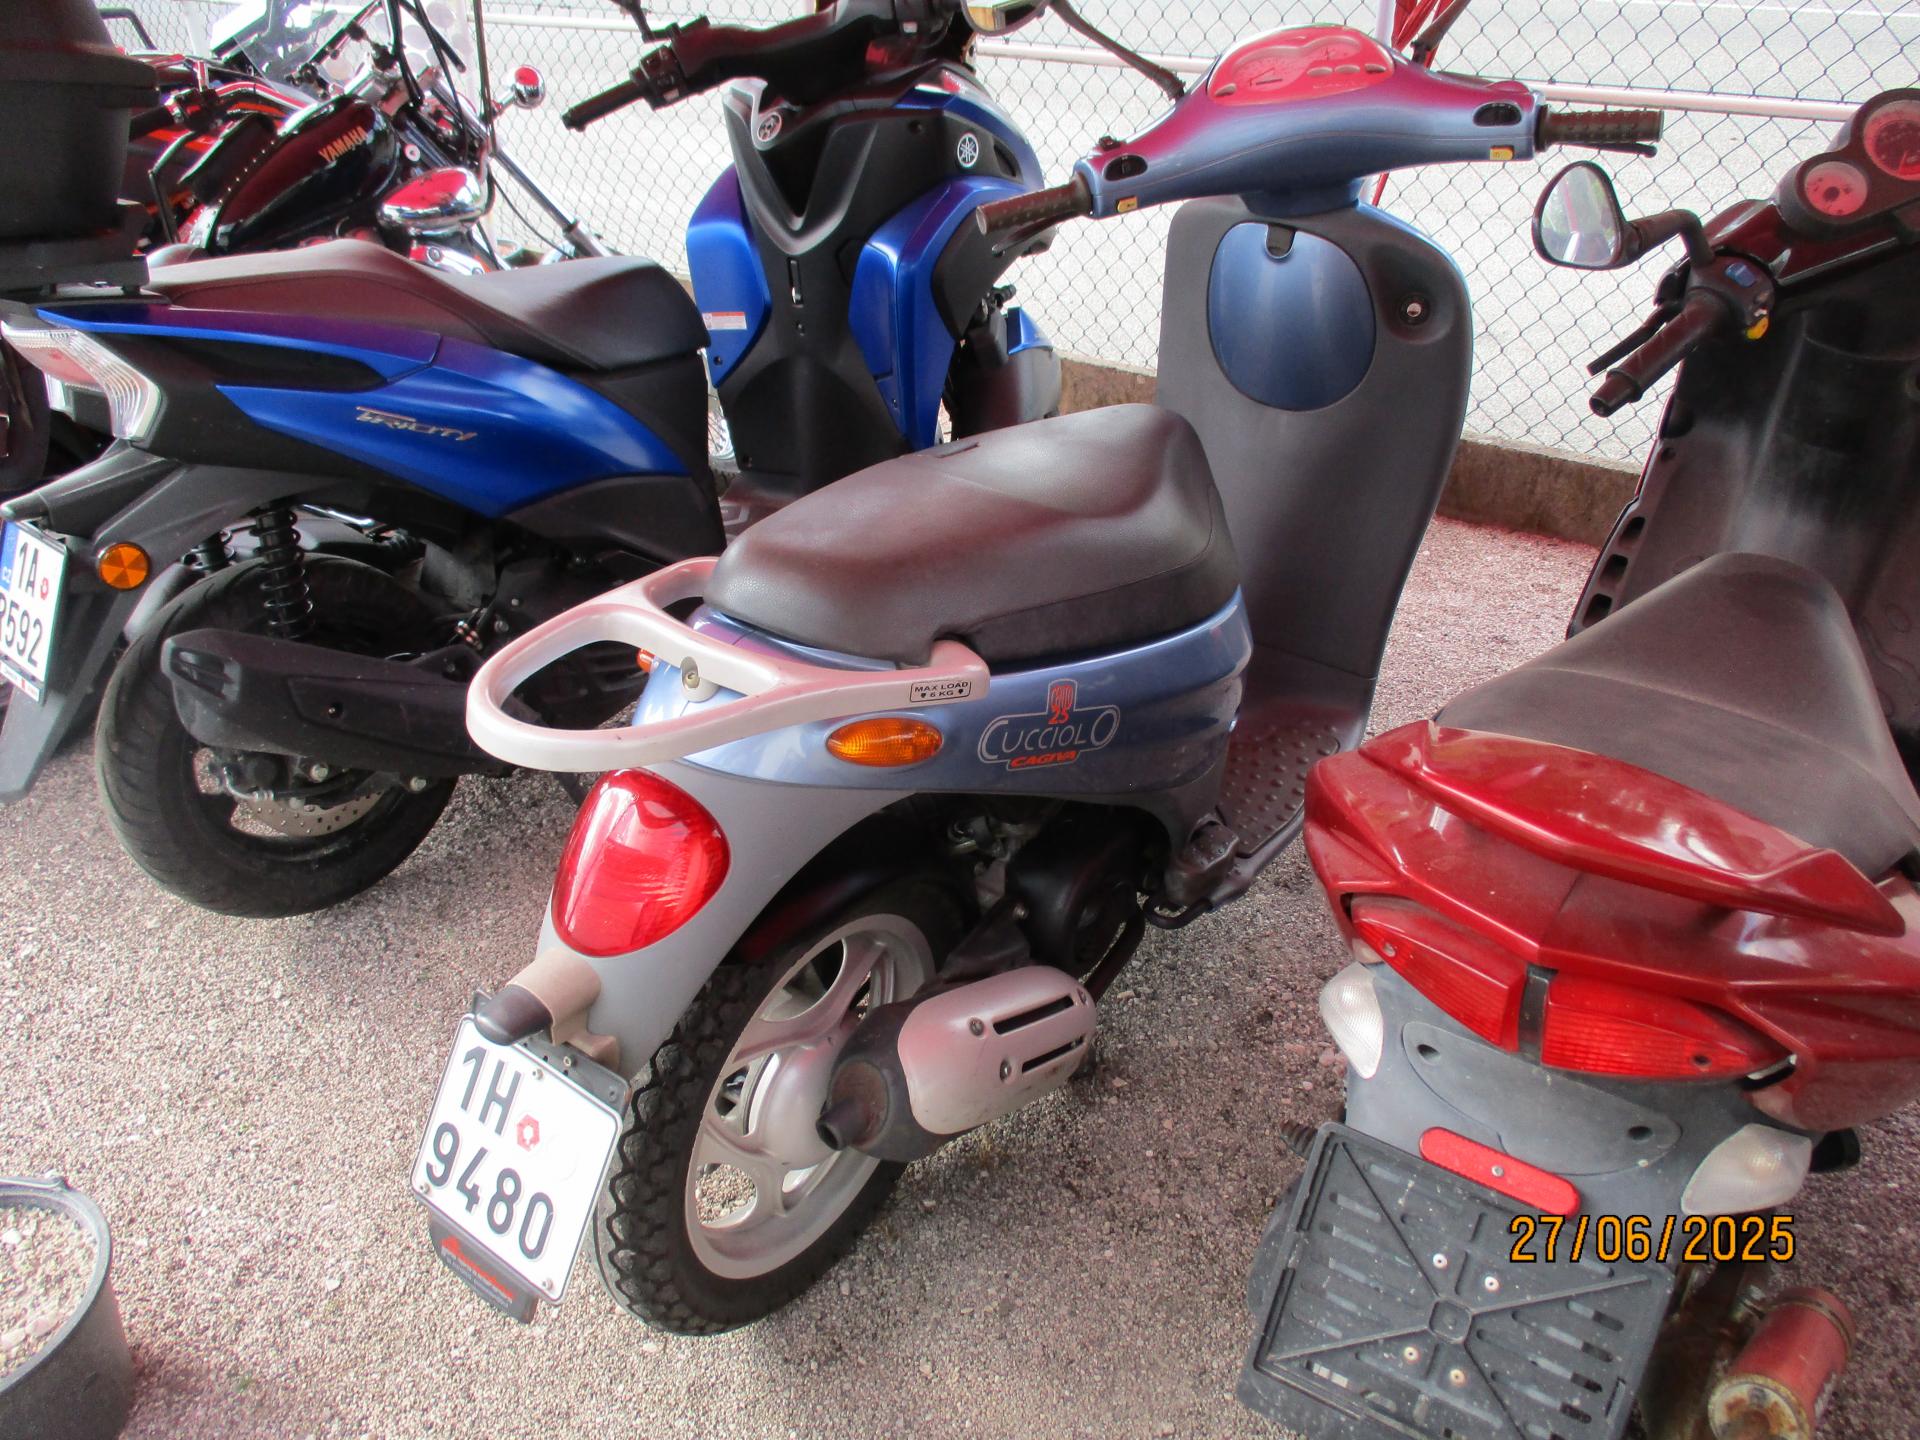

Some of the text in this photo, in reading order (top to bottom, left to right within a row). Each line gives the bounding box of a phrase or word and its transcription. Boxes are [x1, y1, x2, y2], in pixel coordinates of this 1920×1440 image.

[318, 126, 369, 163] YAMAHA
[18, 541, 39, 597] 1A
[914, 681, 969, 693] MAX LOAD
[981, 709, 1118, 760] CUCCIOLO
[1048, 705, 1072, 725] 25
[1010, 750, 1077, 768] CAGIVA
[460, 1046, 522, 1136] 1H
[425, 1122, 555, 1260] 9480
